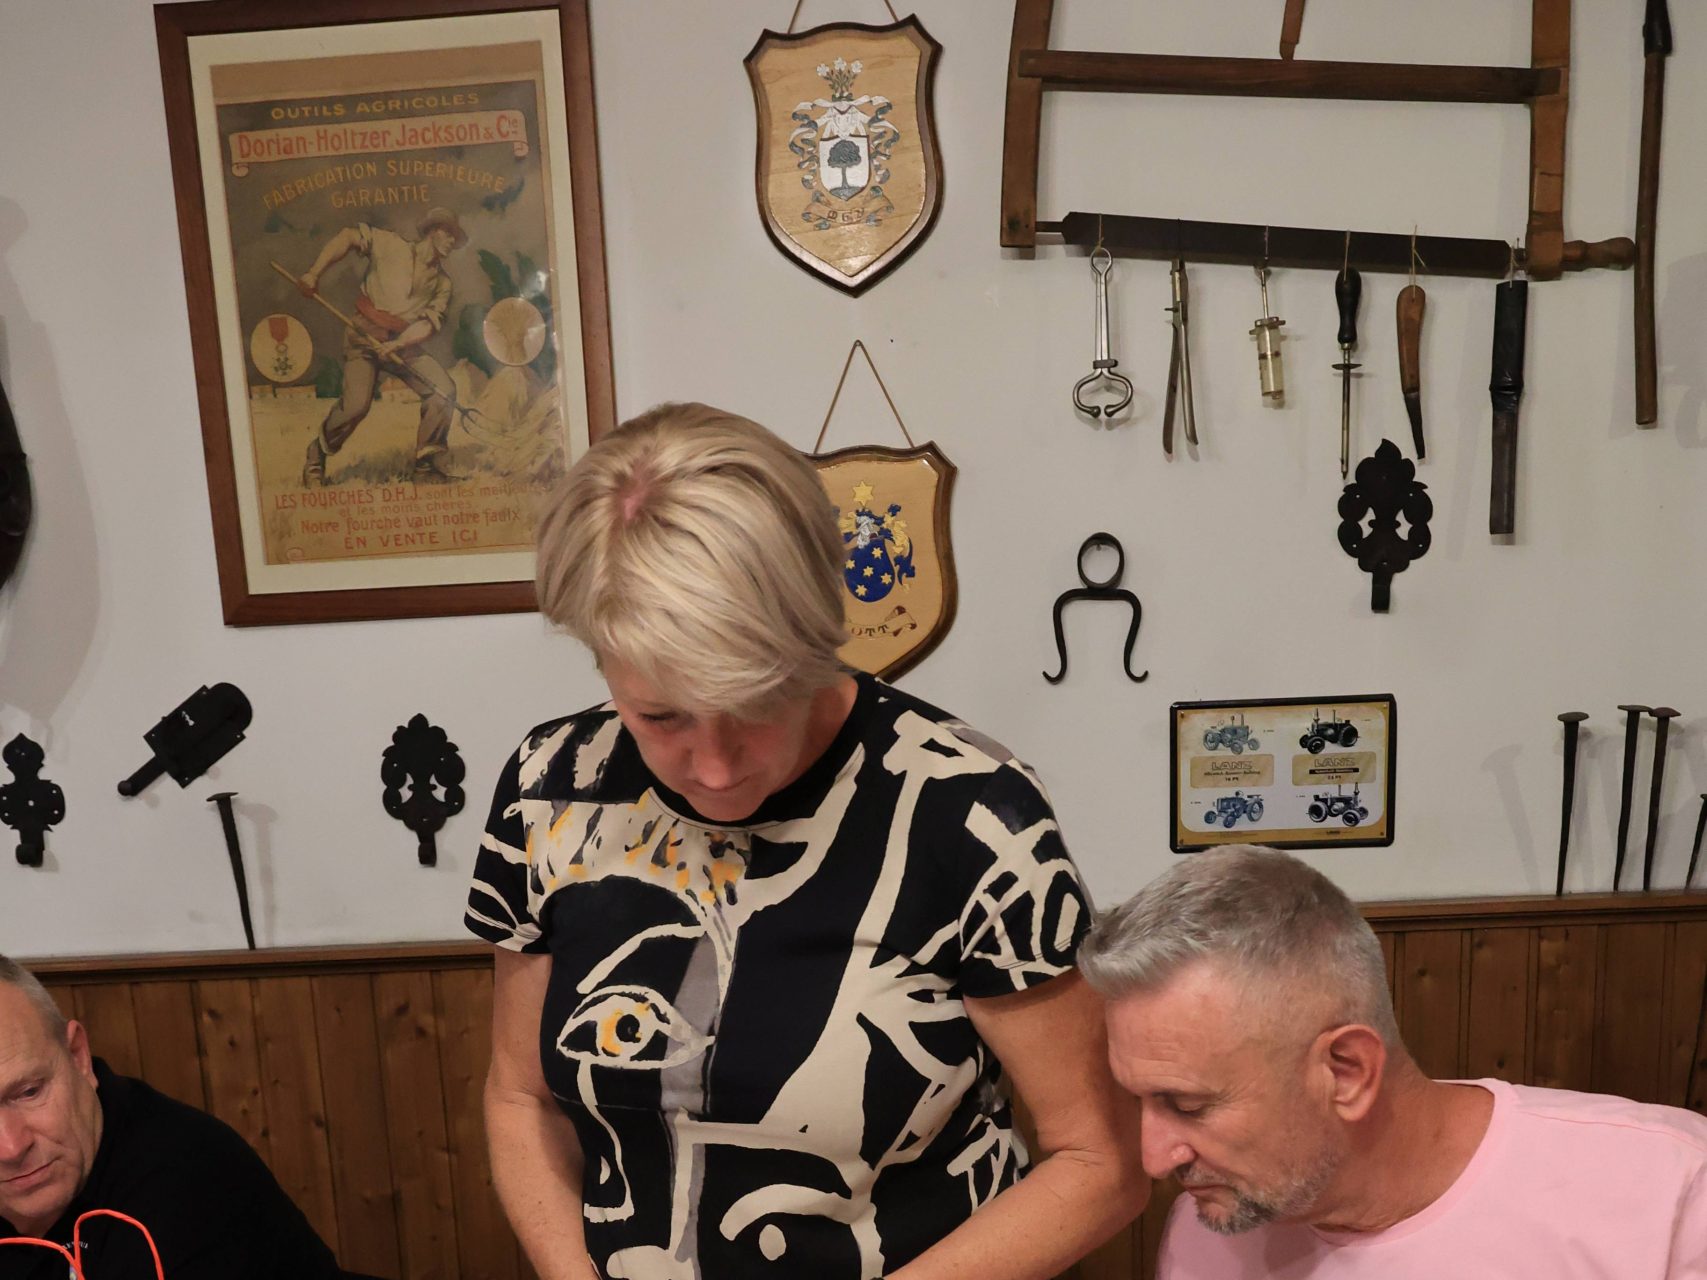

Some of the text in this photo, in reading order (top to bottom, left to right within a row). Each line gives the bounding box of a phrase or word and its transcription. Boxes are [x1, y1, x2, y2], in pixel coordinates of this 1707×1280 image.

[271, 92, 480, 121] OUTILS AGRICOLES
[263, 160, 506, 210] FABRICATION SUPERIEURE
[331, 184, 430, 209] GARANTIE
[275, 494, 297, 510] LES
[301, 489, 374, 510] FOURCHES
[301, 520, 339, 535] Notre
[347, 517, 401, 535] fourche
[406, 515, 439, 528] vaut
[442, 512, 481, 526] notre
[343, 529, 478, 550] EN VENTE ICI
[1211, 761, 1253, 771] LANZ
[1314, 757, 1356, 768] LANZ
